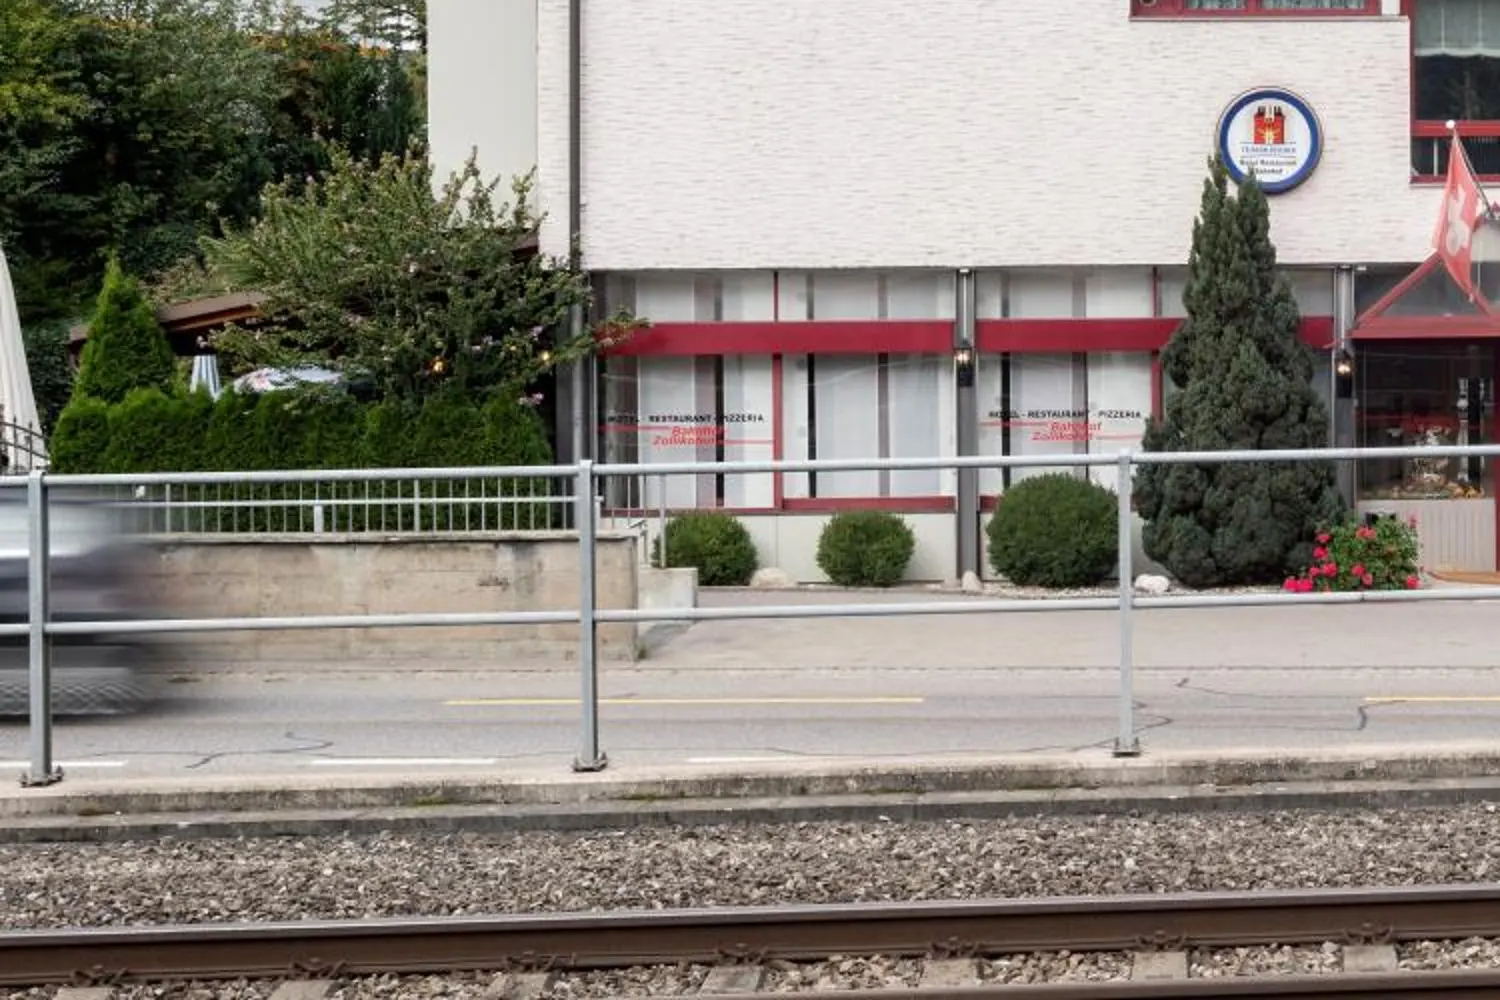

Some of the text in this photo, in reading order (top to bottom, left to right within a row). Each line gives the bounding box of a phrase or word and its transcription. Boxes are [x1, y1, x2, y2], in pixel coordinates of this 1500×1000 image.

[649, 414, 712, 423] RESTAURANT
[1028, 410, 1089, 418] RESTAURANT
[1098, 410, 1141, 419] PIZZERIA
